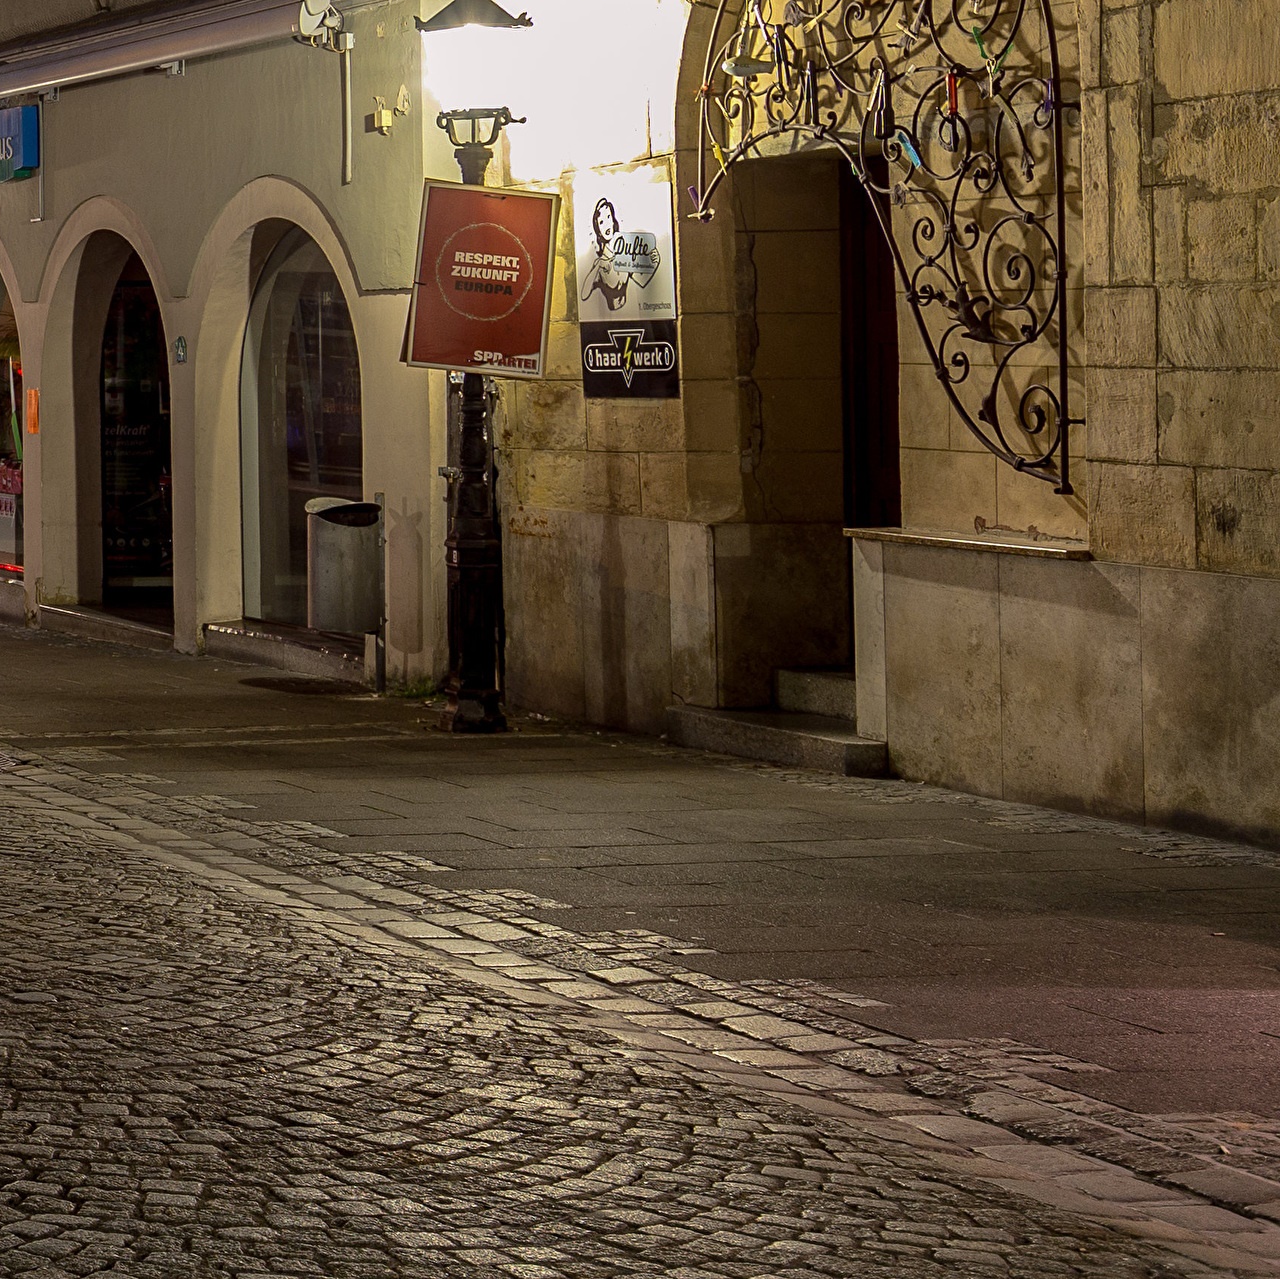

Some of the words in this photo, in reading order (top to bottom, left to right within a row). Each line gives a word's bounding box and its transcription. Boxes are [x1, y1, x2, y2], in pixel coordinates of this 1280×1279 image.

[613, 235, 652, 262] Dufte
[454, 251, 520, 270] RESPEKT,
[450, 265, 520, 282] ZUKUNFT
[454, 280, 513, 296] EUROPA
[473, 349, 503, 362] SPD
[595, 348, 621, 367] haar
[633, 347, 663, 366] werk
